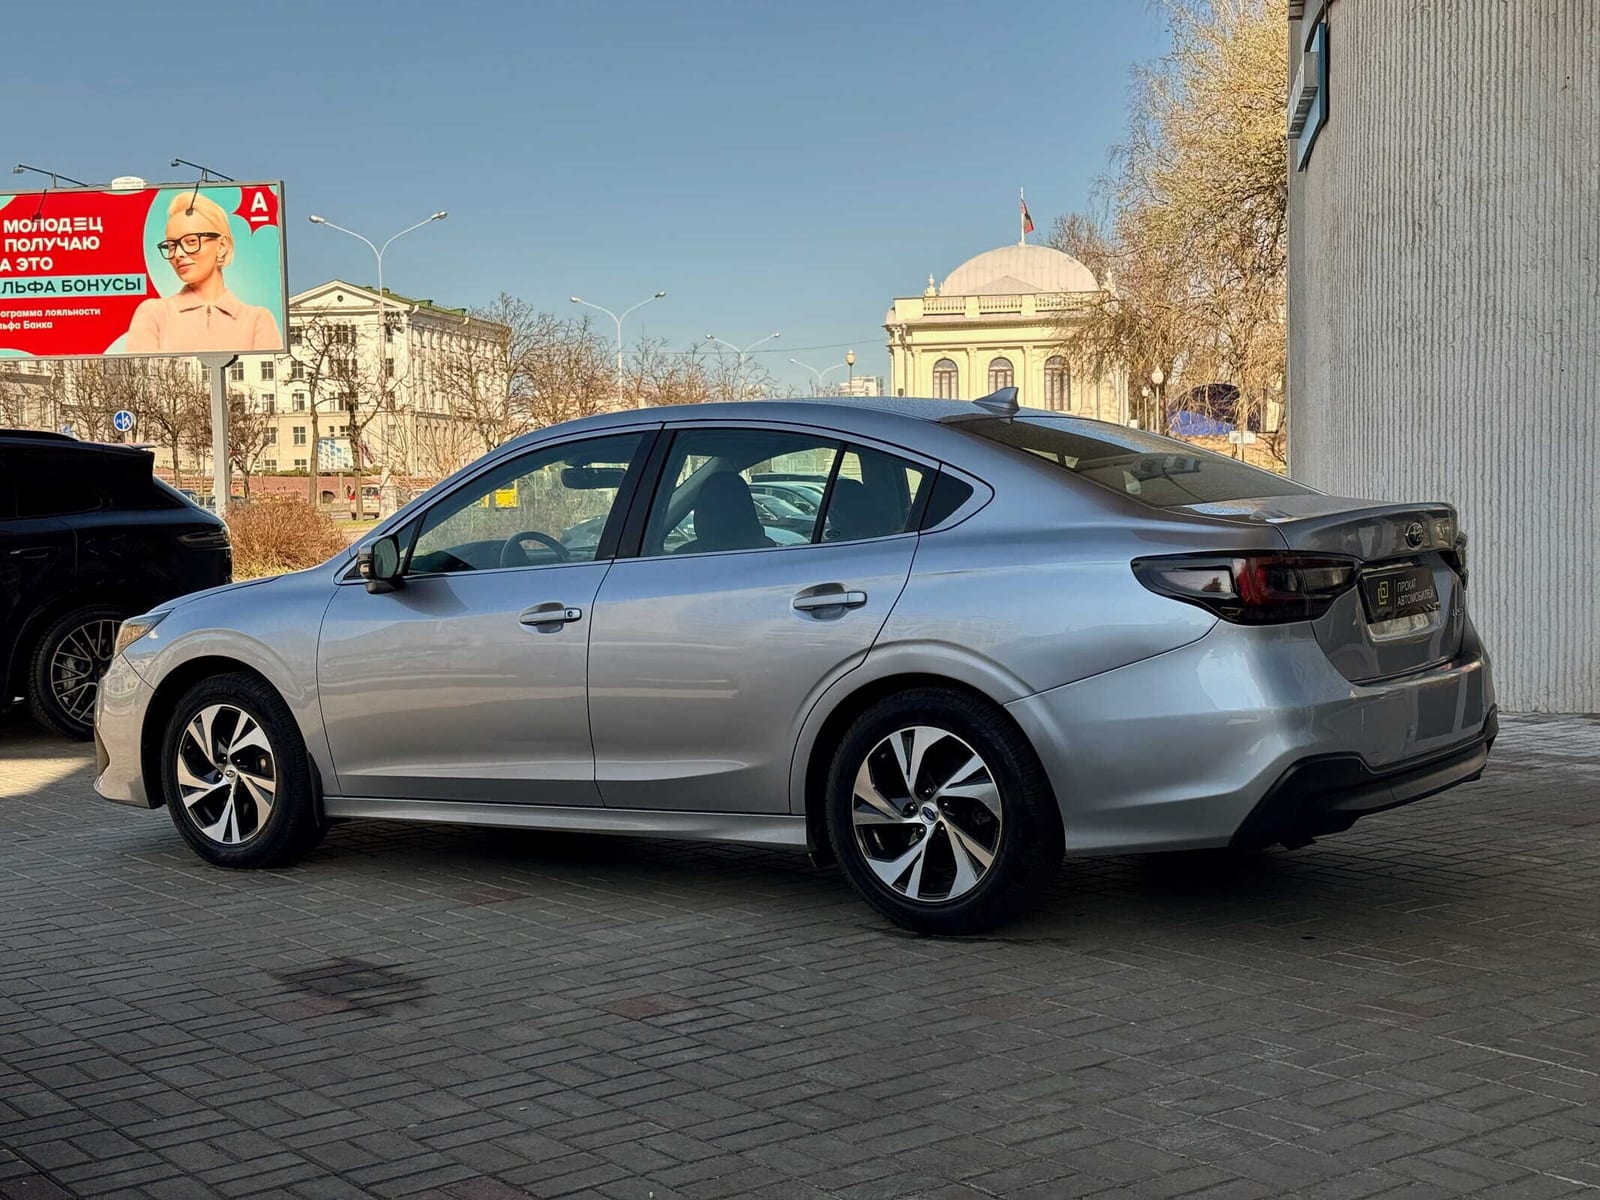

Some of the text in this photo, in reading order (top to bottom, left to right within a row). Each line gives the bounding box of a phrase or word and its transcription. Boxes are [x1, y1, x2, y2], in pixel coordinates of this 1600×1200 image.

[4, 235, 101, 253] ПОЛУЧАЮ
[16, 256, 54, 272] ЭТО
[1, 277, 142, 295] ЛЬФА БОНУСЫ
[45, 307, 101, 317] лояльности
[23, 320, 53, 330] Банка
